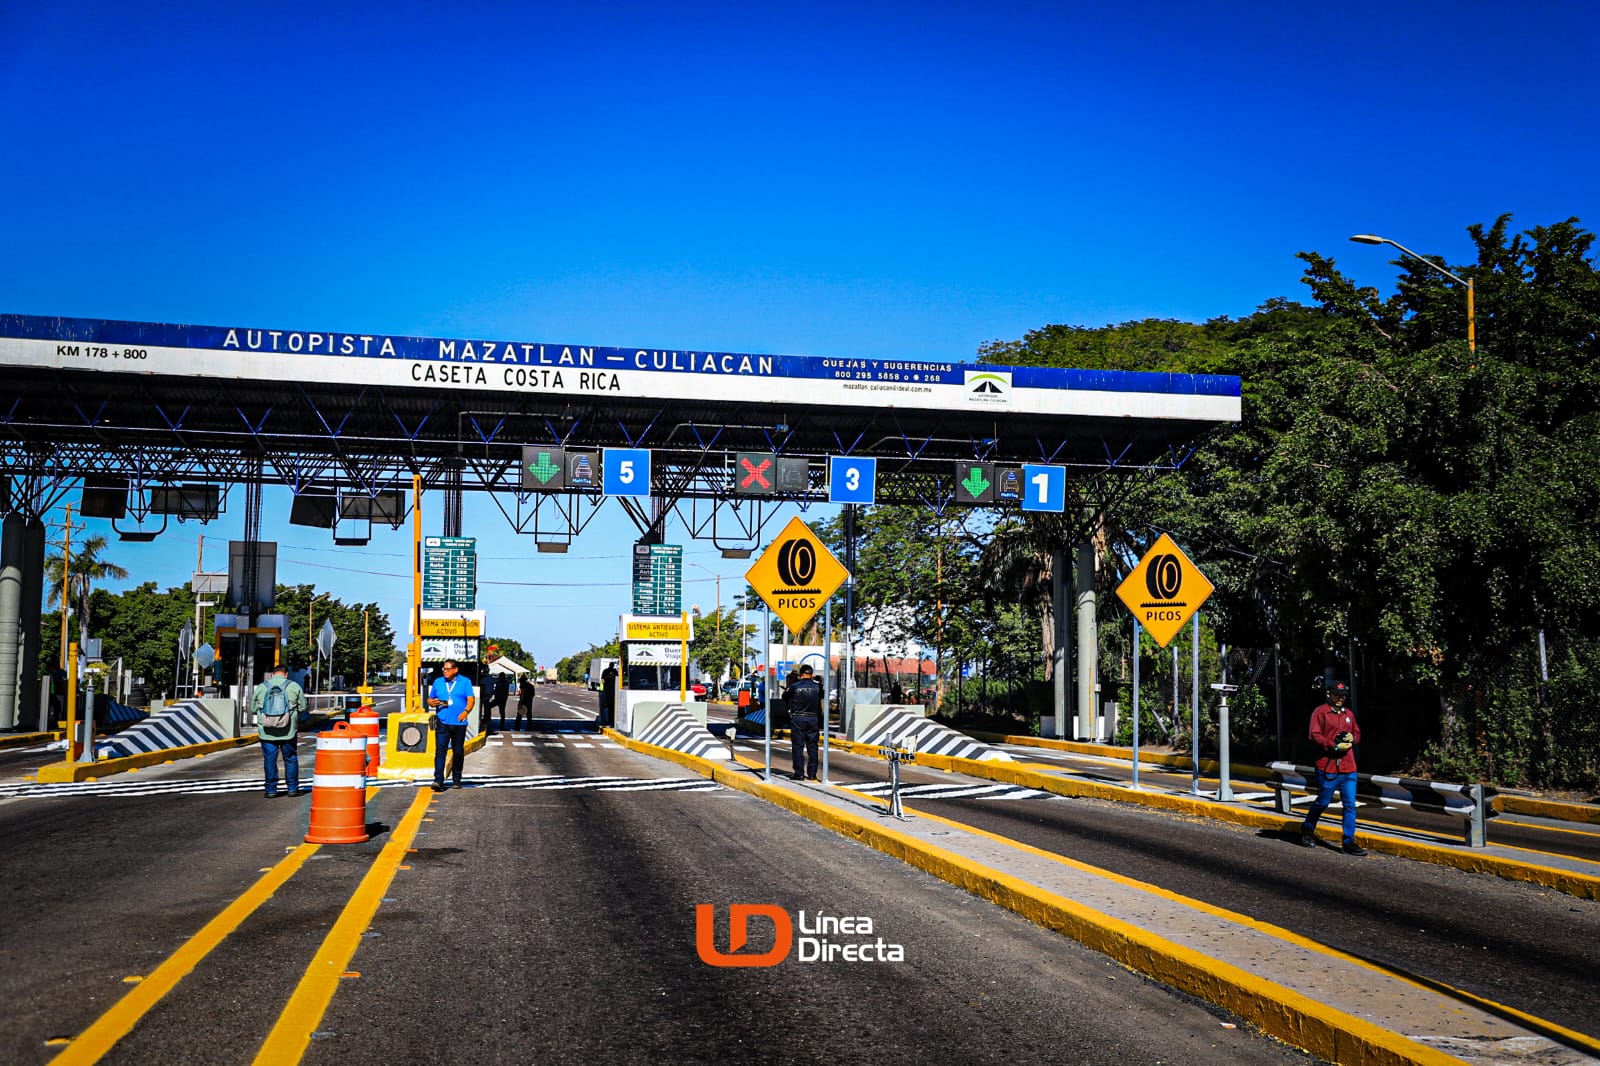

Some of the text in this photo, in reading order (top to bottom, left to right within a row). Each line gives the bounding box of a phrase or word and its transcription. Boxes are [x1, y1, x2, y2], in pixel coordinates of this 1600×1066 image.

[57, 345, 148, 361] KM 178 + 800
[223, 329, 396, 358] AUTOPISTA
[437, 340, 595, 367] MAZATLAN
[634, 350, 774, 376] CULIACAN
[822, 359, 953, 373] QUEJAS Y SUGERENCIAS
[834, 370, 851, 379] 800
[855, 371, 872, 380] 295
[877, 372, 900, 382] 5858
[411, 363, 621, 392] CASETA COSTA RICA
[619, 460, 635, 484] 5
[845, 467, 861, 491] 3
[1031, 473, 1049, 504] 1
[778, 597, 816, 609] PICOS
[1146, 610, 1182, 622] PICOS
